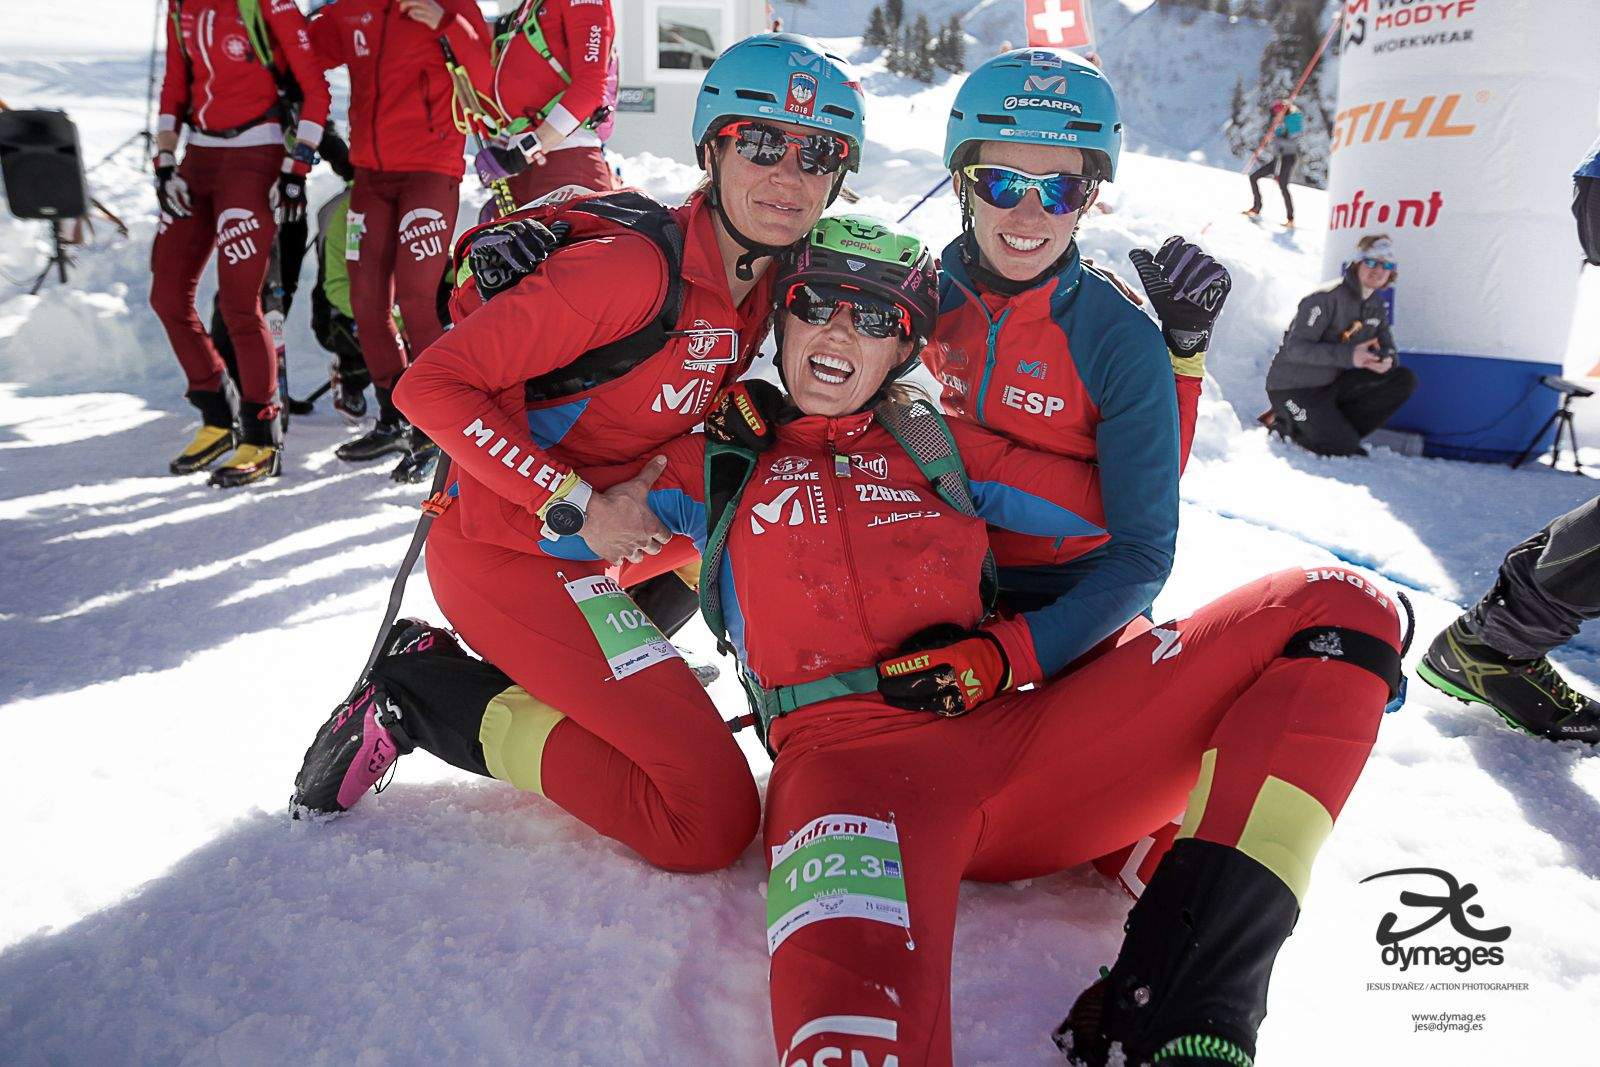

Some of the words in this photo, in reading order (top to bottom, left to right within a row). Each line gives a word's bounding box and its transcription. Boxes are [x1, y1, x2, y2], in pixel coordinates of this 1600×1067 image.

[1375, 0, 1477, 31] MODYF
[584, 25, 602, 62] Suisse
[1373, 30, 1475, 55] WORKWEAR
[789, 103, 808, 115] 2018
[1017, 98, 1082, 115] SCARPA
[1330, 94, 1477, 155] STIHL
[400, 217, 448, 245] skinfit
[224, 236, 258, 265] SUI
[409, 235, 442, 261] SUI
[695, 379, 714, 414] MILLET
[1005, 386, 1065, 418] ESP
[736, 394, 761, 431] MILLET
[462, 418, 566, 493] MILLET
[813, 485, 828, 525] MILLET
[855, 484, 922, 502] 226ERS
[1305, 569, 1389, 609] FEDME
[885, 655, 930, 676] MILLET
[794, 820, 868, 850] infront
[785, 853, 882, 892] 102.3
